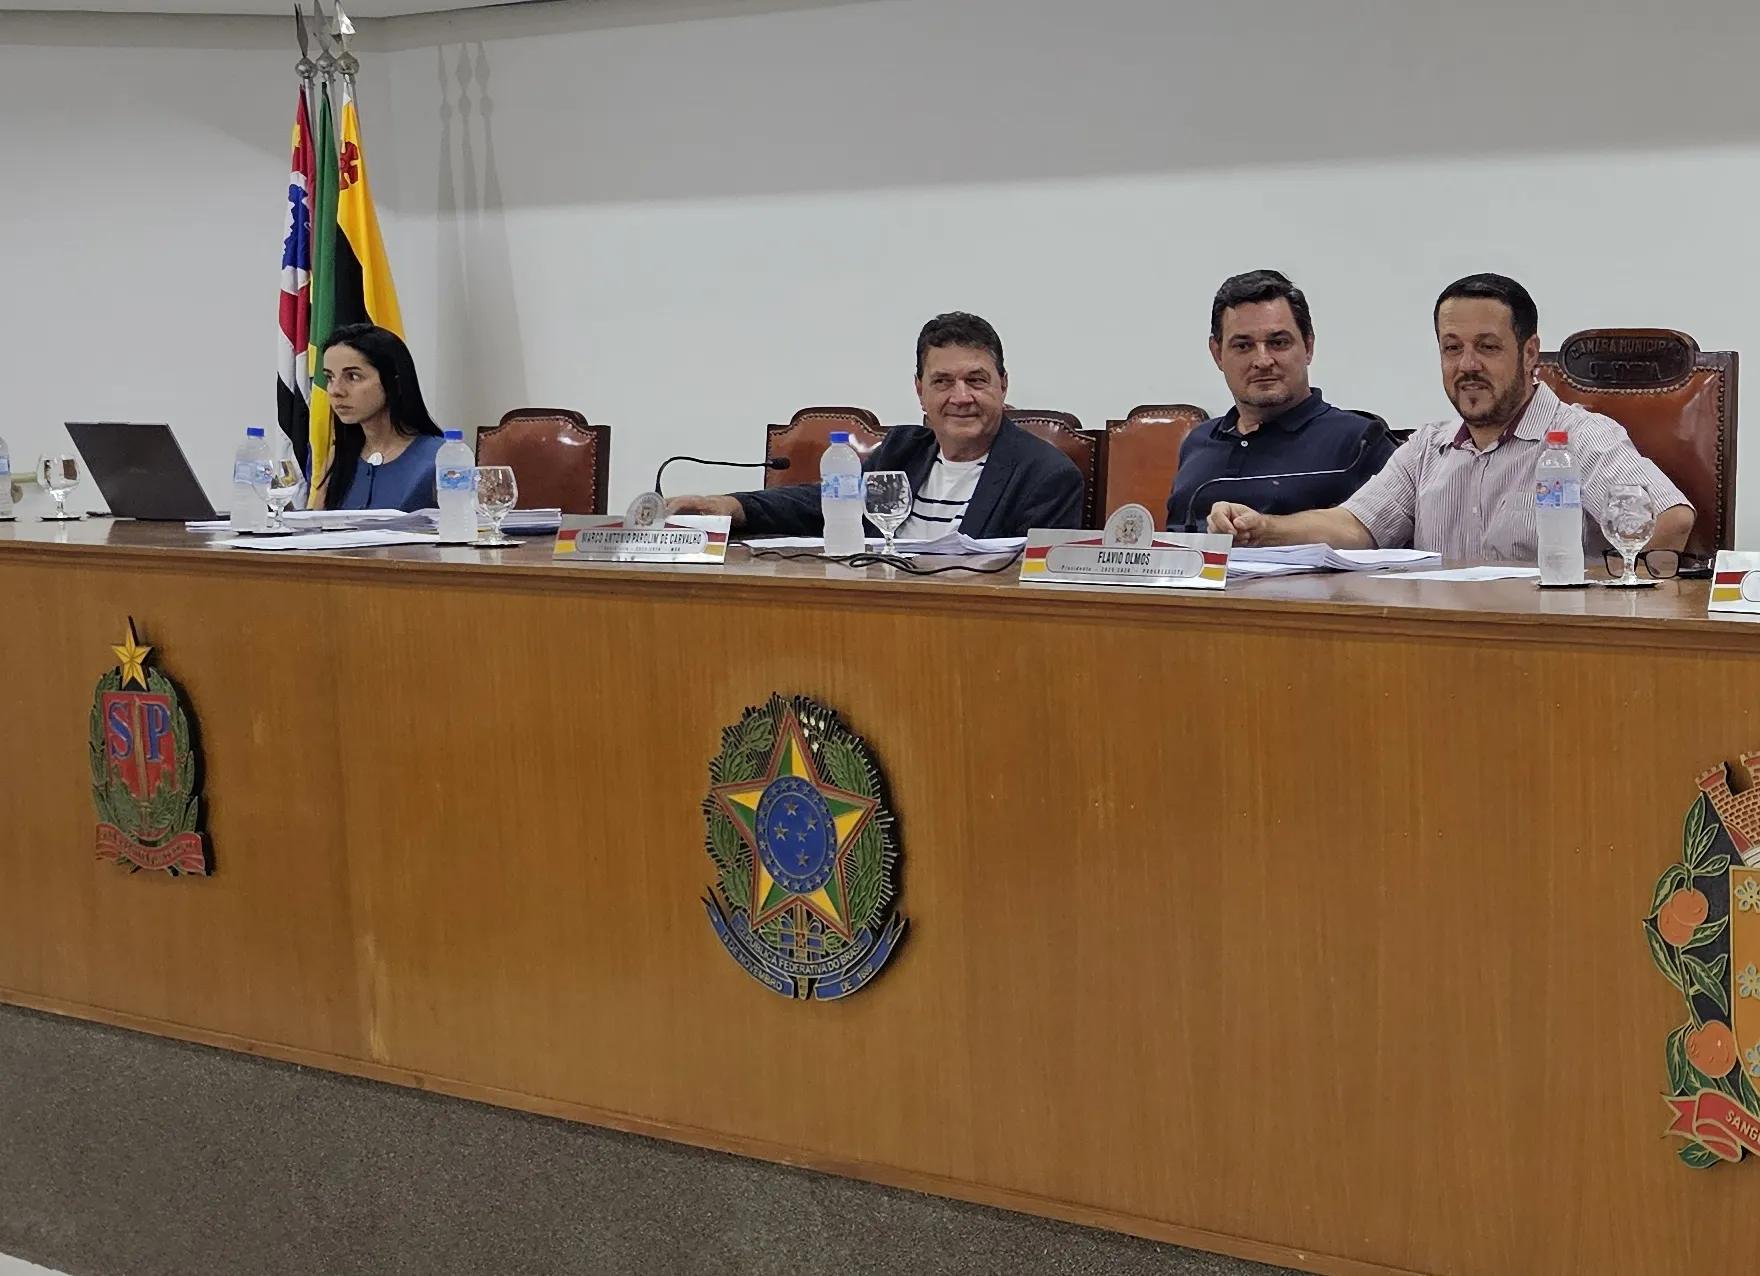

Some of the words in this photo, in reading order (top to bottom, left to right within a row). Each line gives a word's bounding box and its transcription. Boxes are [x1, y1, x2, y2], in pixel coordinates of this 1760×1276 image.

[582, 532, 604, 544] MARCO
[604, 532, 631, 544] ANTONIO
[659, 533, 669, 545] DE
[669, 533, 702, 545] CARVALHO
[1097, 551, 1123, 564] FLAVIO
[1125, 552, 1151, 565] OLMOS
[778, 957, 828, 975] FEDERATIVA
[827, 959, 841, 971] DO
[840, 978, 853, 993] DE
